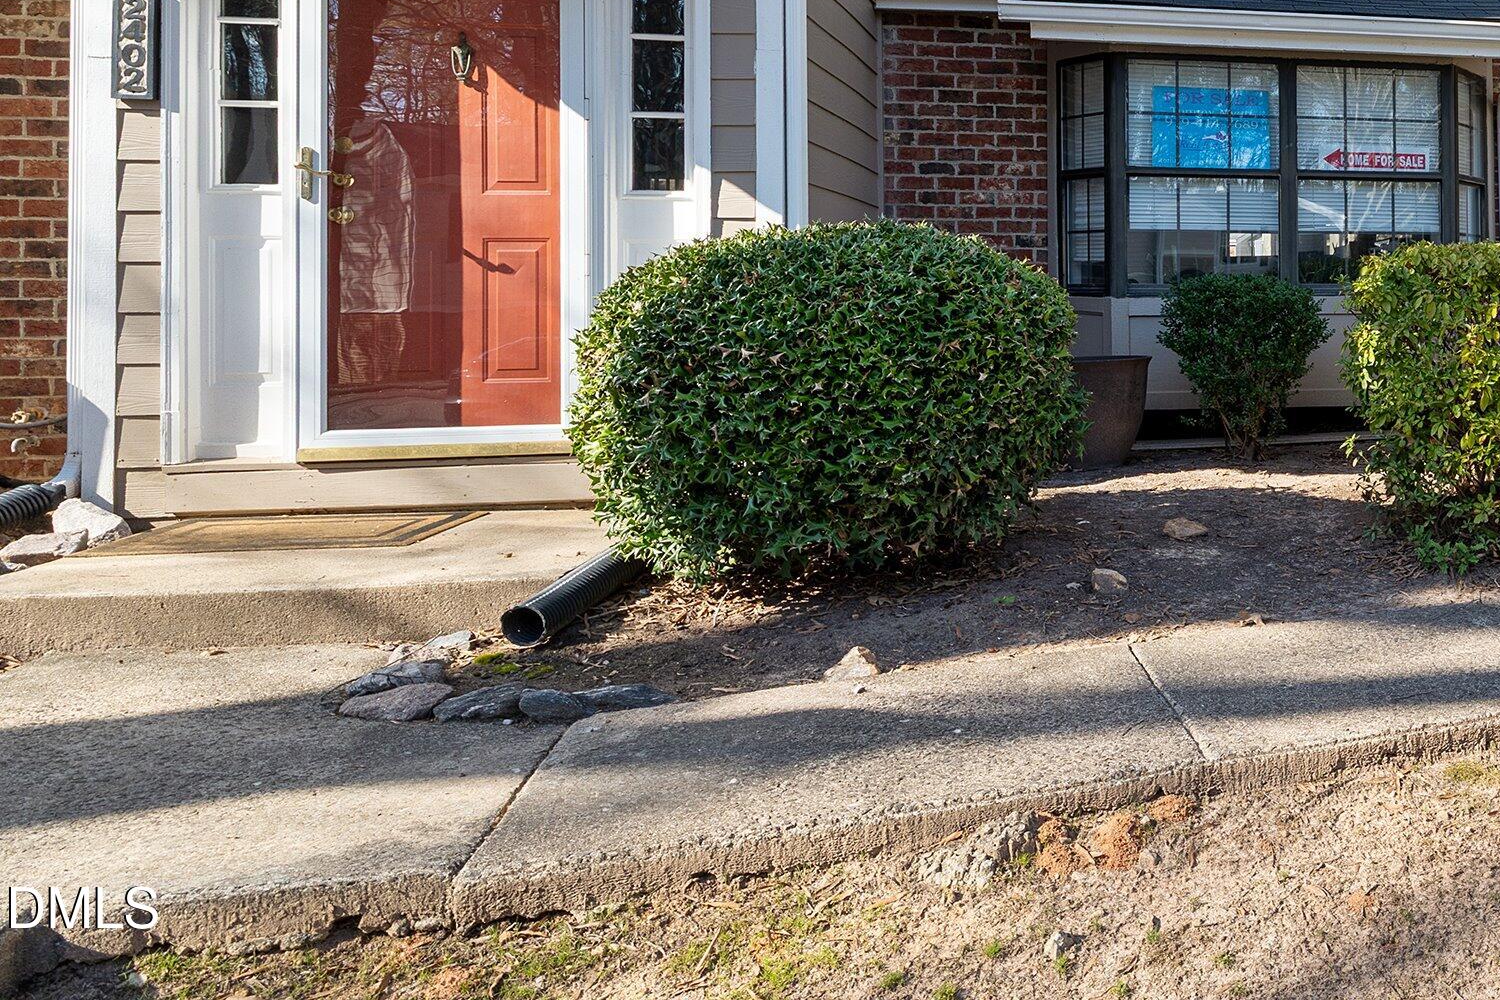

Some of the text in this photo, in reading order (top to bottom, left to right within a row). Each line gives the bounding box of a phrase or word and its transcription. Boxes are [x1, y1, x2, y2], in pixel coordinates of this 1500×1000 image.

[1340, 153, 1425, 168] HOME FOR SALE
